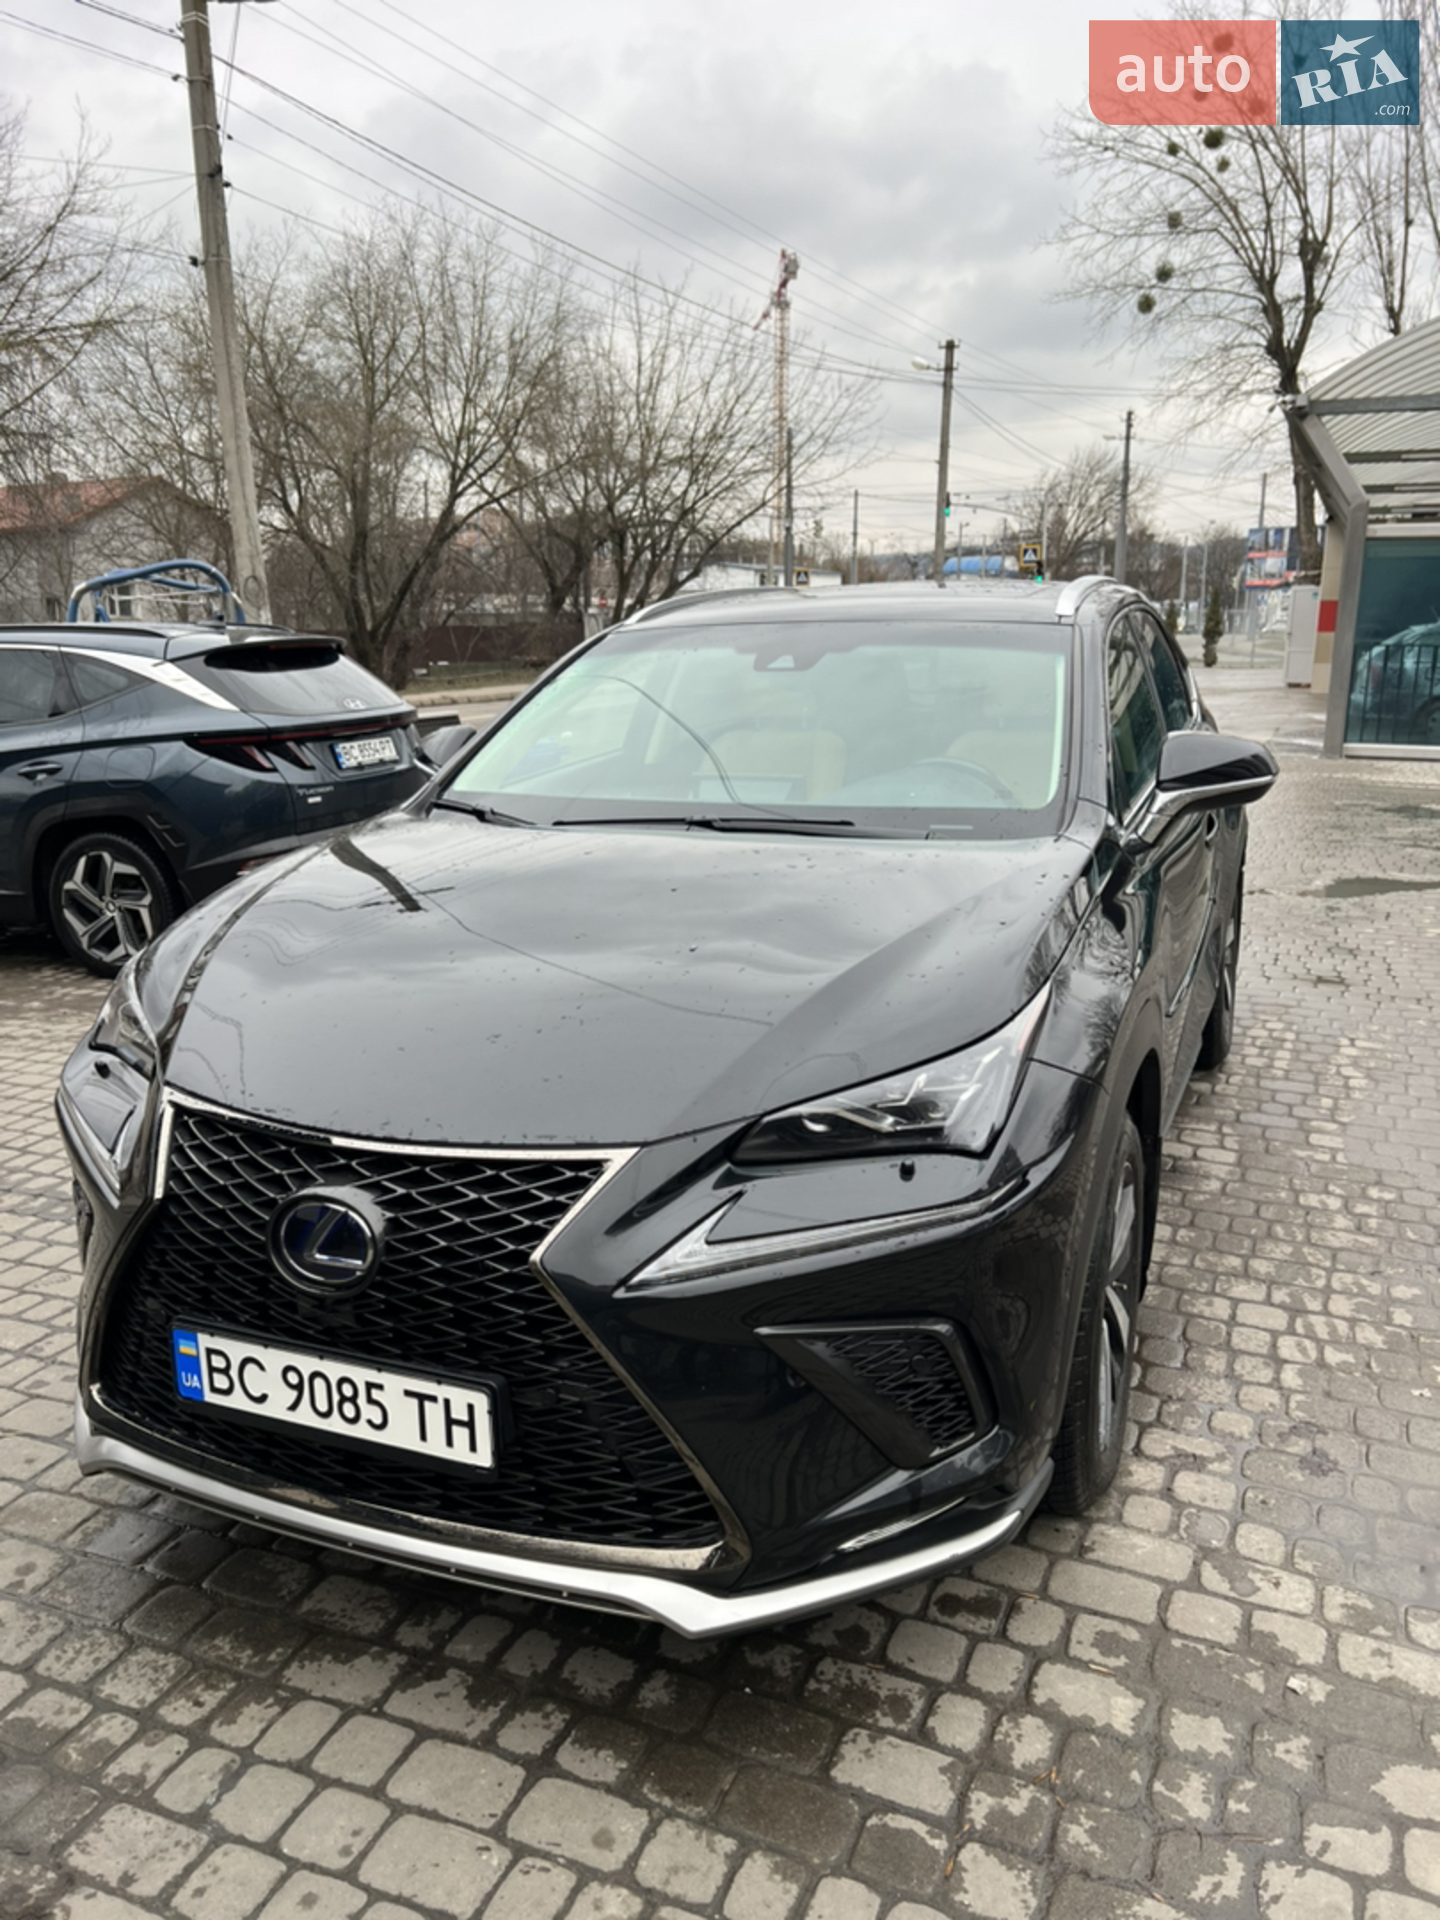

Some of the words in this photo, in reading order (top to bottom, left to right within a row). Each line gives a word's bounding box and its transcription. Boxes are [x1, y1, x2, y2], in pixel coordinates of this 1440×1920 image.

[181, 1372, 201, 1389] UA
[205, 1347, 269, 1405] BC
[281, 1365, 389, 1431] 9085
[403, 1389, 478, 1454] TH
